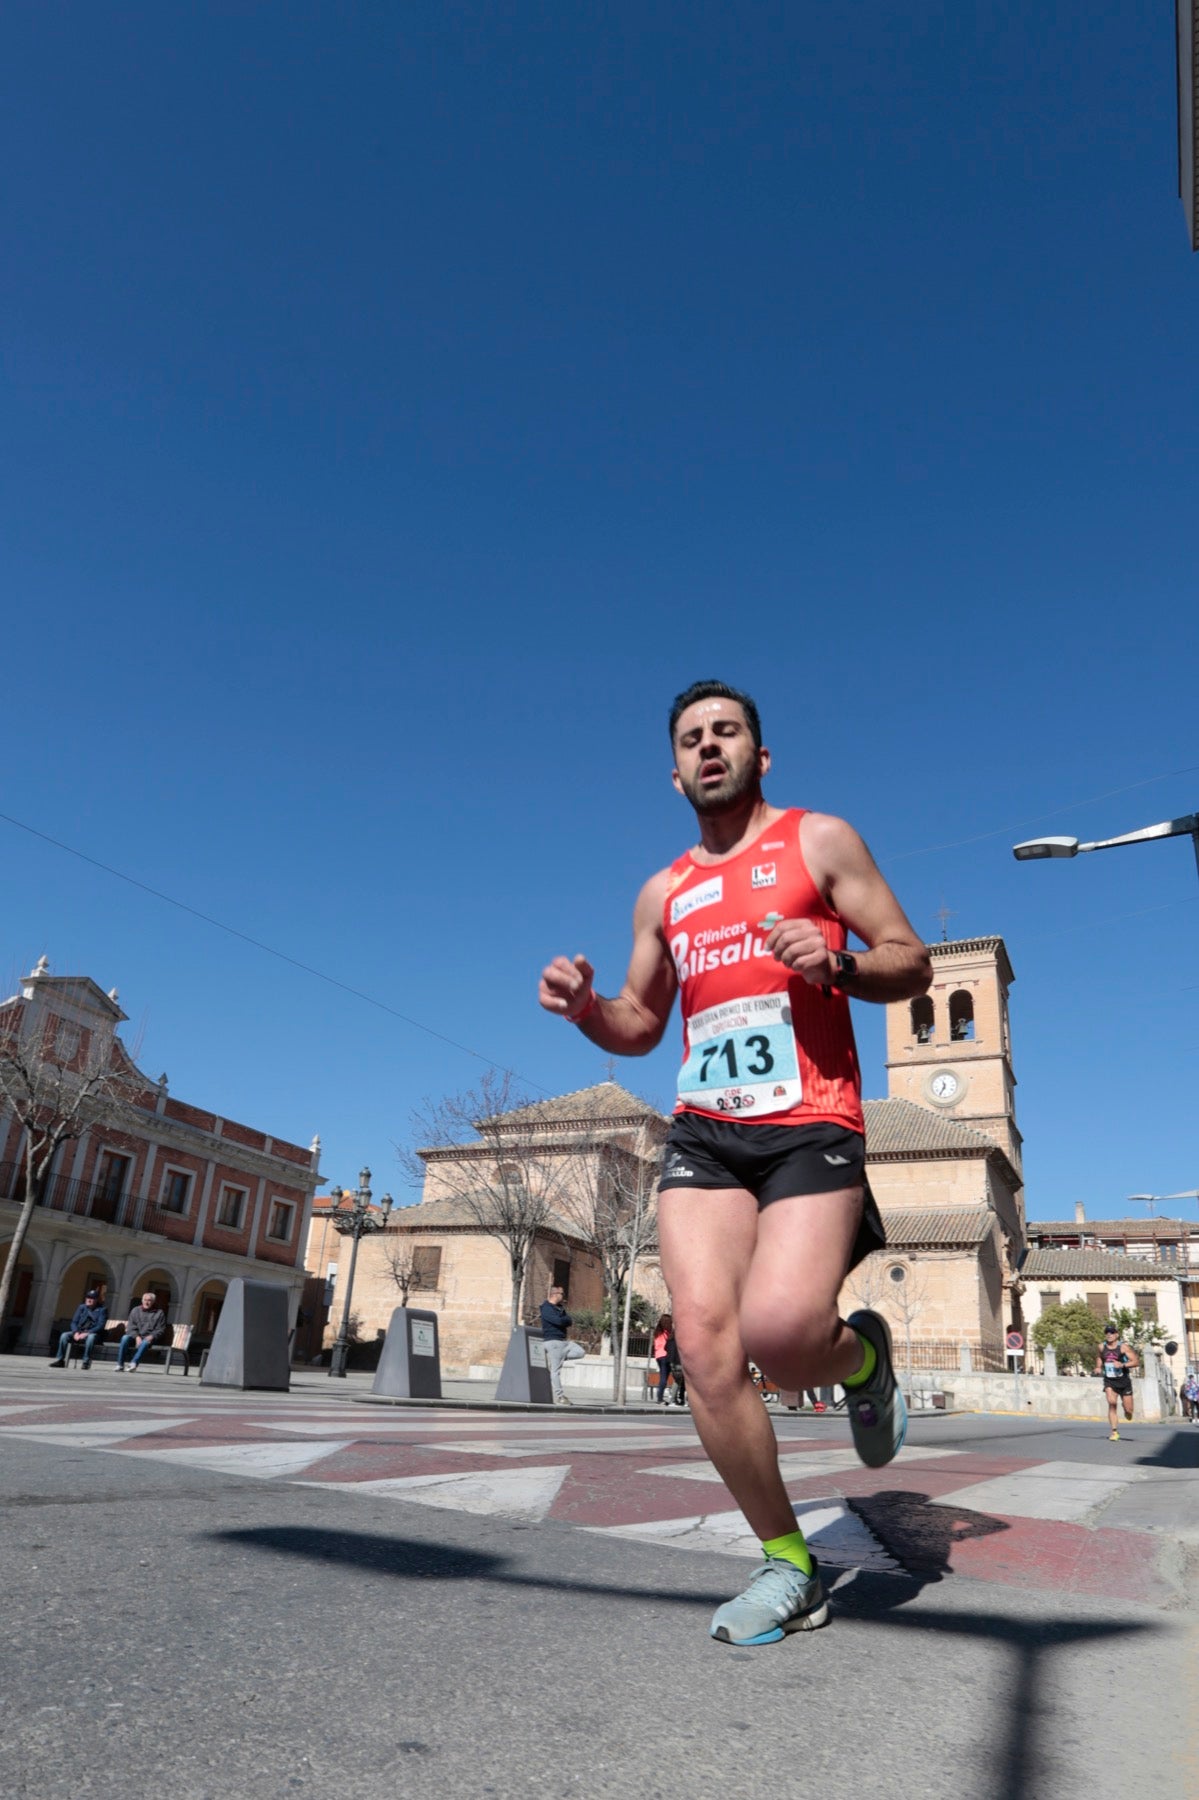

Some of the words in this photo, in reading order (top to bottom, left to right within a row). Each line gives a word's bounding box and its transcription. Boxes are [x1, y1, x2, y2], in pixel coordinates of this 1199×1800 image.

[693, 921, 748, 948] Clínicas
[670, 931, 774, 984] Polisalu
[753, 998, 782, 1012] FONDO
[699, 1034, 775, 1082] 713
